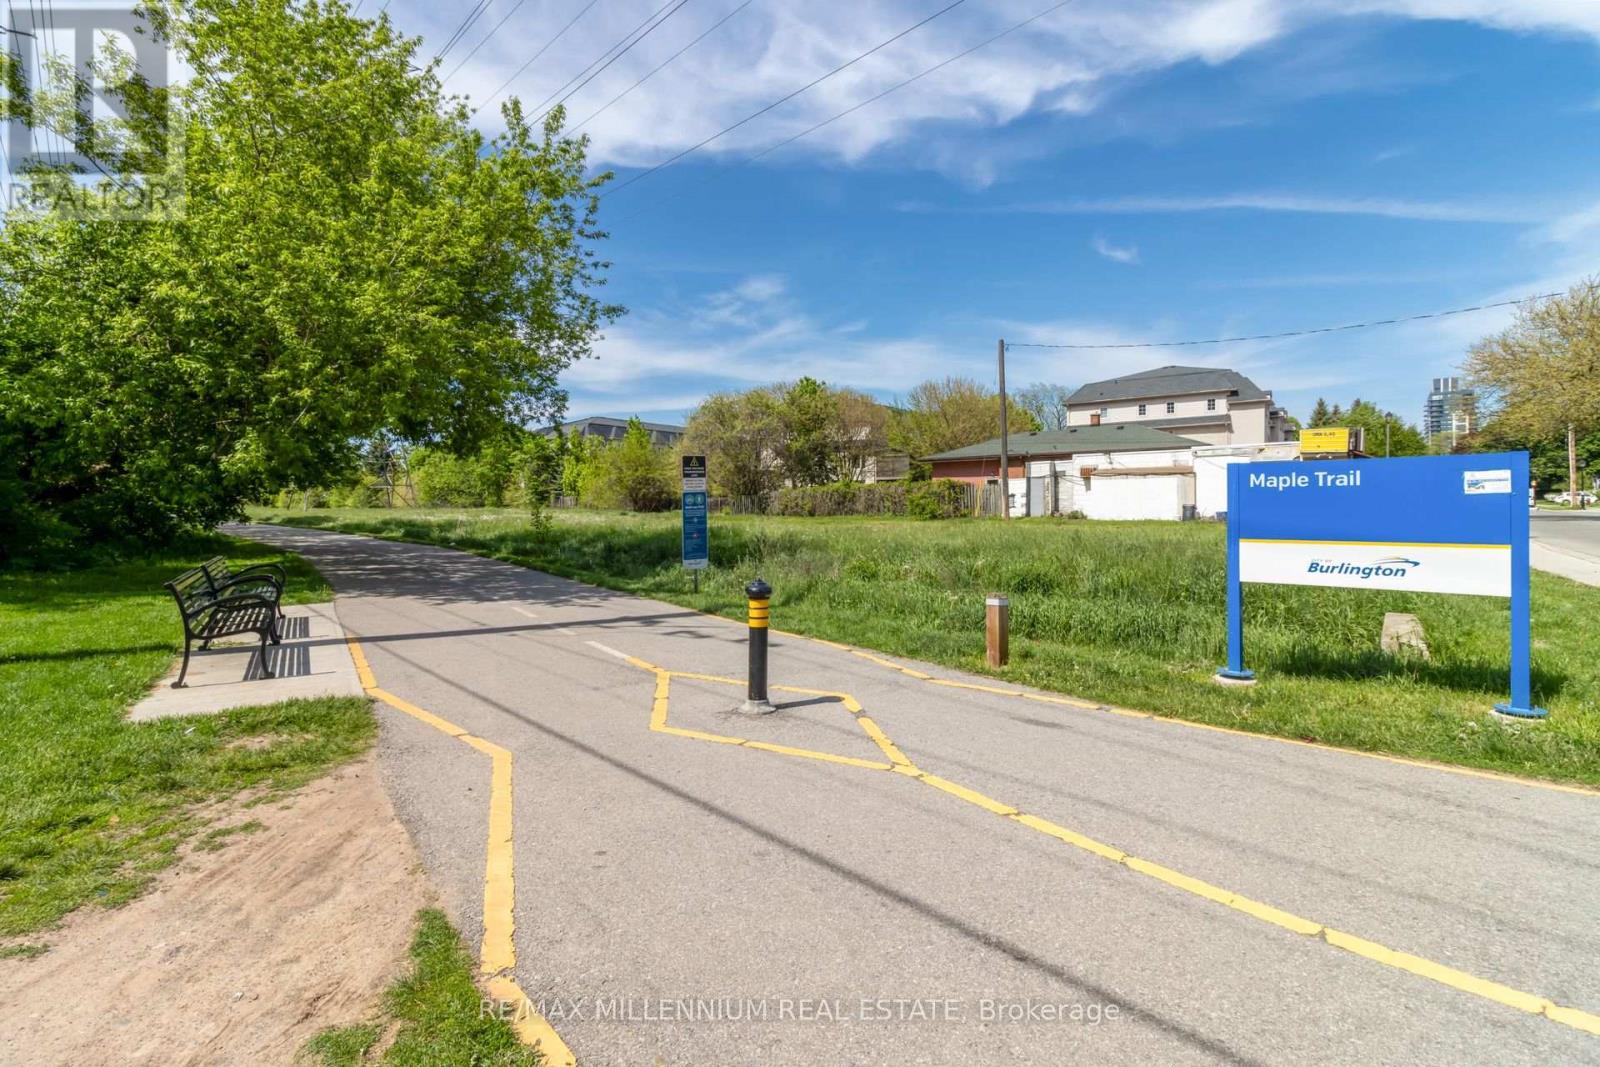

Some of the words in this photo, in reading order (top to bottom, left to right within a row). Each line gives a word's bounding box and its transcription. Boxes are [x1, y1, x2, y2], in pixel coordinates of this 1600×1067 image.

[1249, 471, 1309, 491] Maple
[1314, 470, 1361, 487] Trail
[1307, 562, 1406, 579] Burlington
